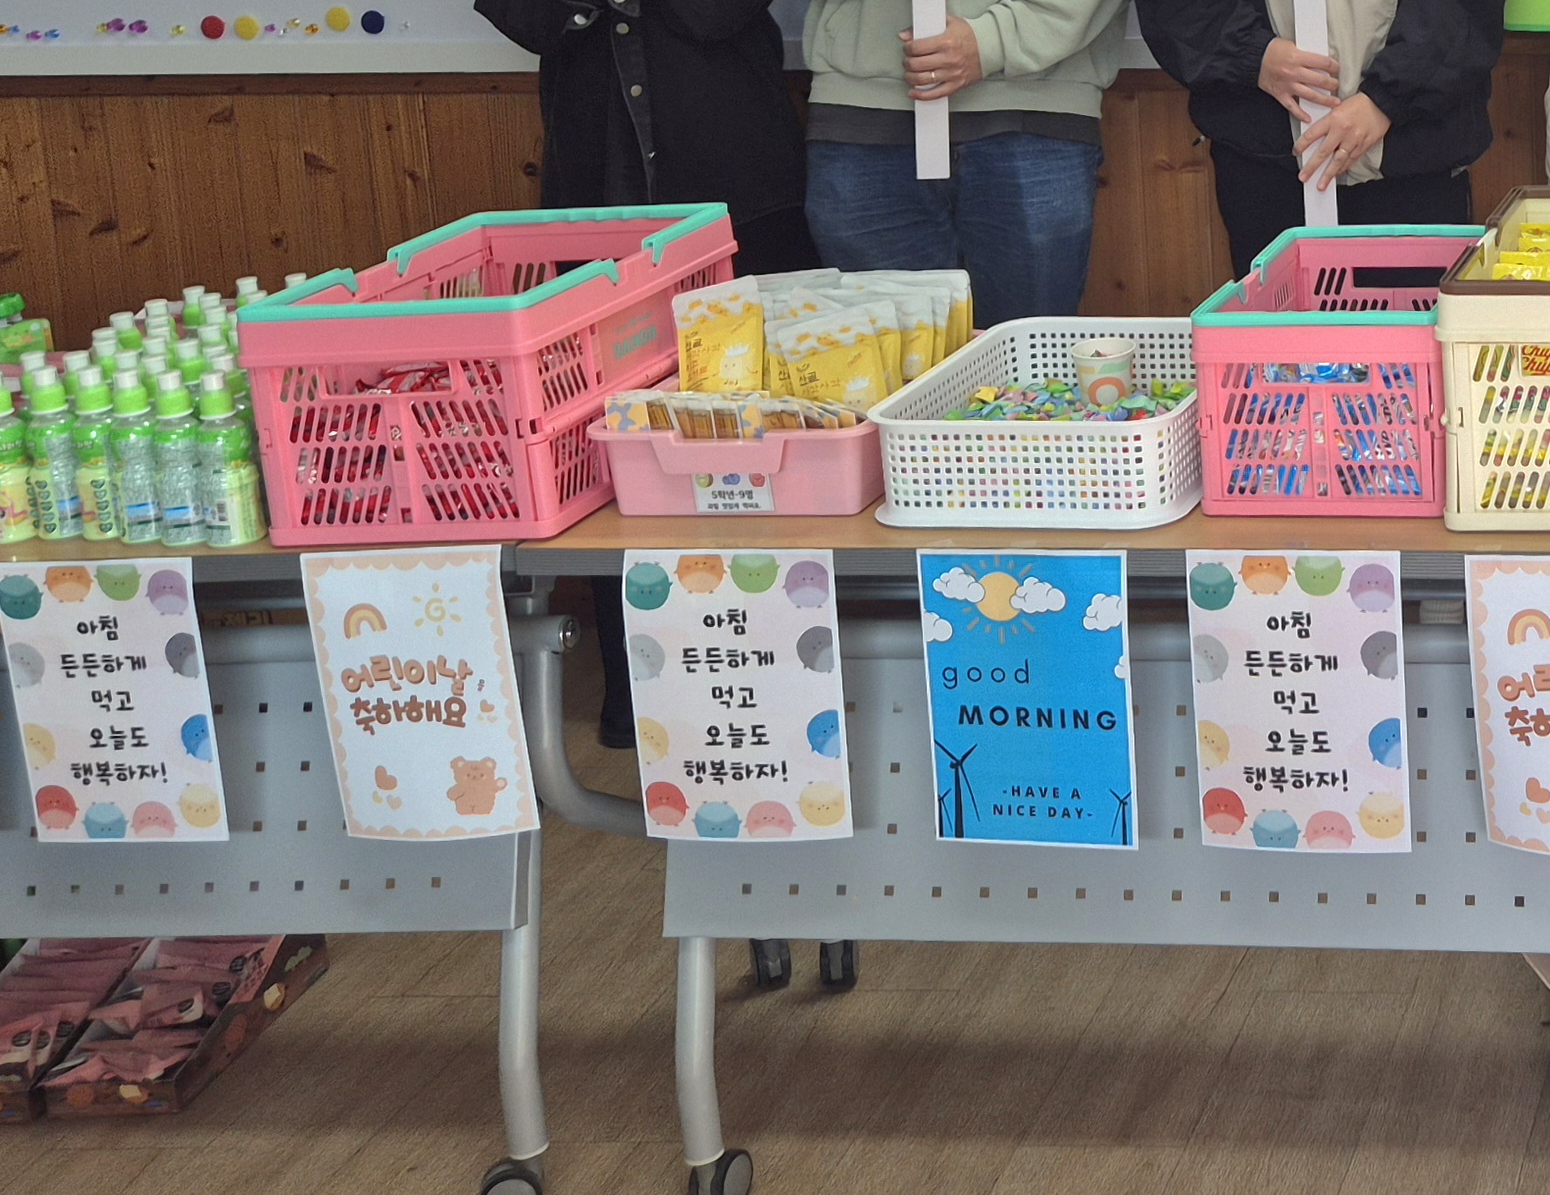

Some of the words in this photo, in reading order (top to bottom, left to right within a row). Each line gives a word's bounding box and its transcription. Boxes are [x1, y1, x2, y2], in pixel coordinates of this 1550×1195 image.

[77, 615, 119, 640] 아침
[703, 608, 748, 635] 아침
[1266, 611, 1312, 638] 아침
[60, 654, 147, 678] 든든하게
[681, 647, 775, 673] 든든하게
[1244, 650, 1339, 677] 든든하게
[341, 654, 473, 696] 어린이날
[942, 658, 1030, 690] good
[91, 689, 135, 712] 먹고
[711, 685, 758, 709] 먹고
[1273, 690, 1320, 715] 먹고
[350, 694, 467, 736] 축하해요
[958, 704, 1117, 731] MORNING
[89, 725, 149, 751] 오늘도
[704, 723, 770, 749] 오늘도
[1265, 728, 1332, 755] 오늘도
[70, 762, 168, 786] 행복하자!
[683, 759, 788, 785] 행복하자!
[1243, 766, 1349, 793] 행복하자!
[1071, 788, 1081, 799] A
[993, 804, 1037, 817] NICE
